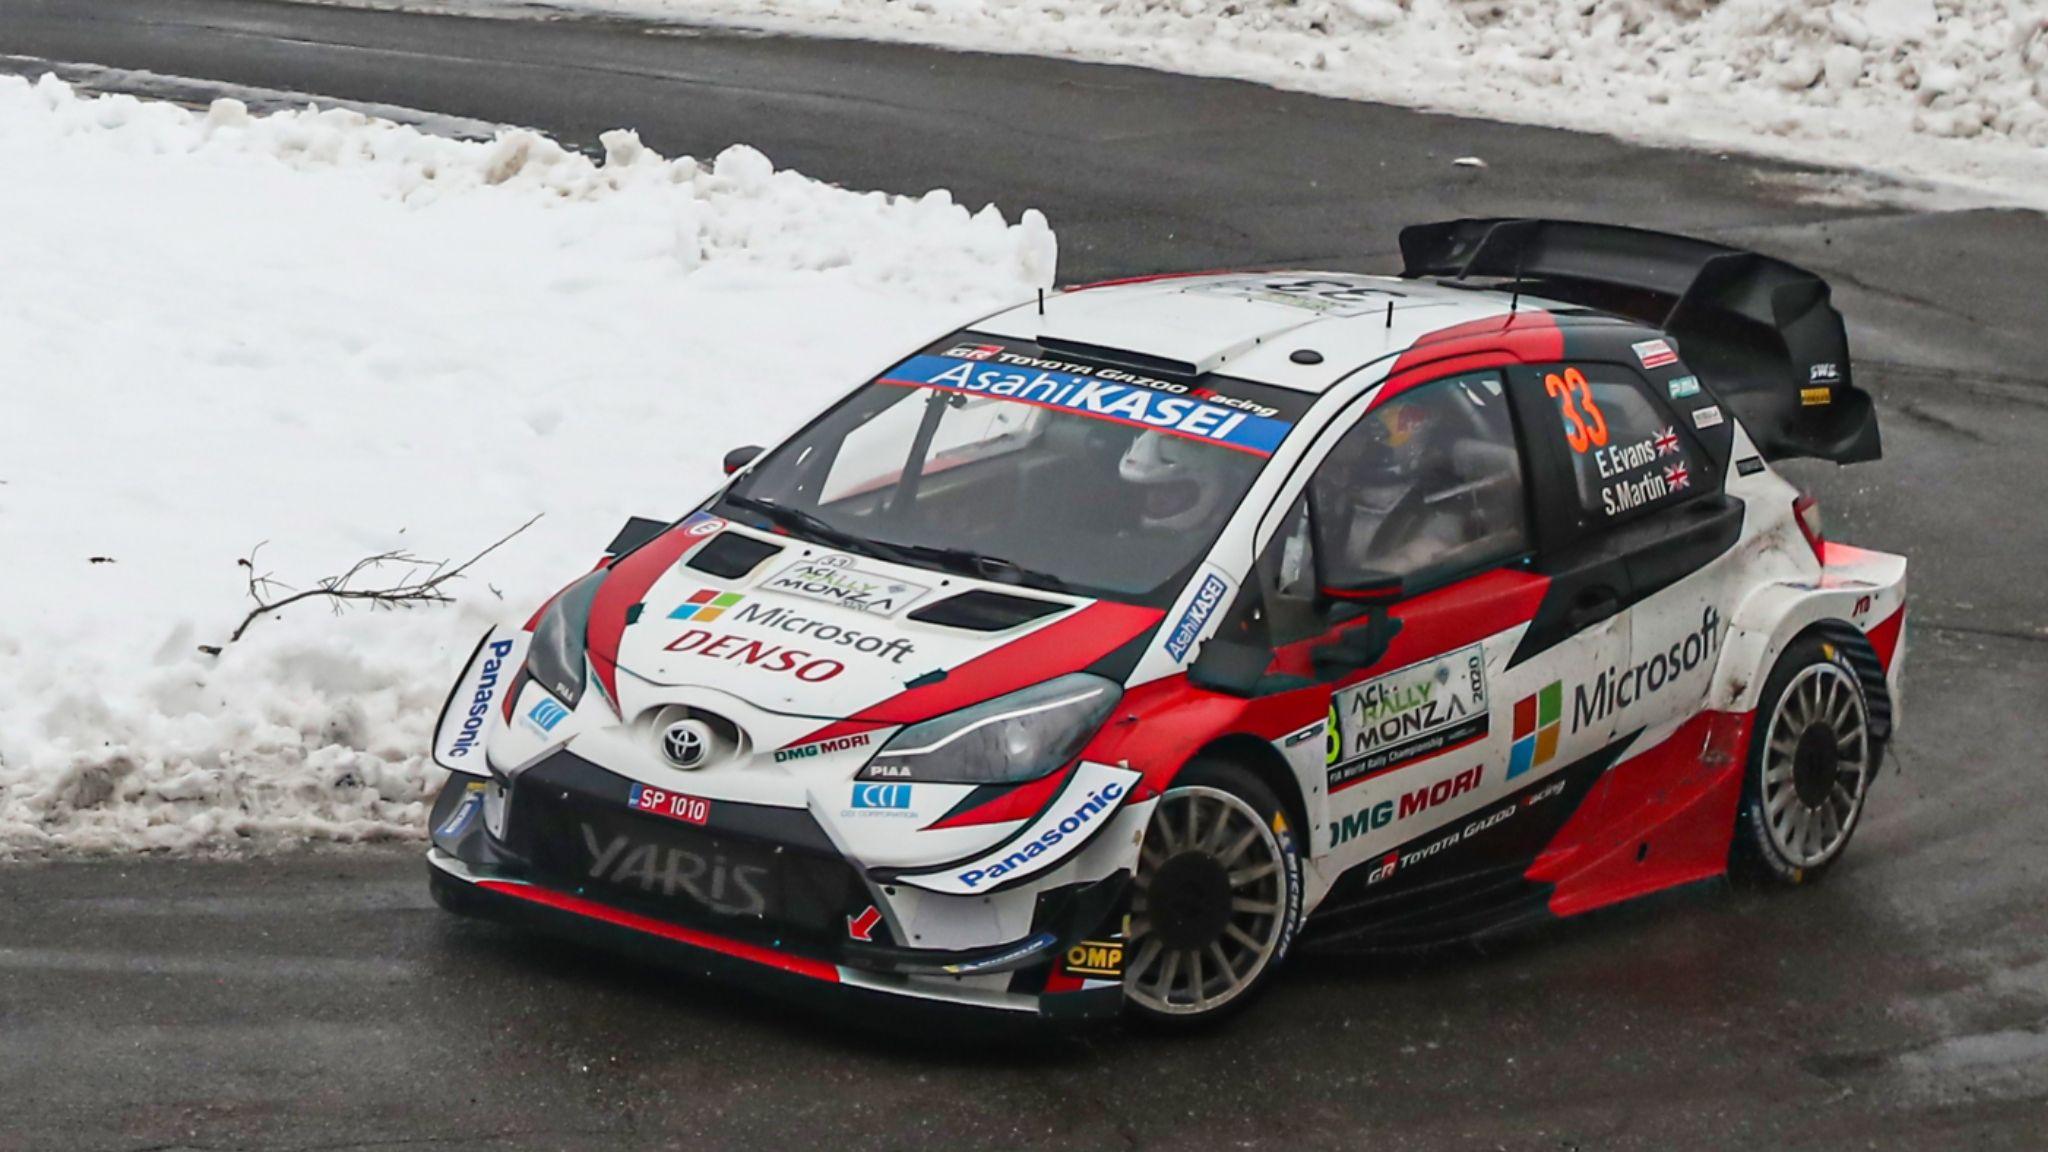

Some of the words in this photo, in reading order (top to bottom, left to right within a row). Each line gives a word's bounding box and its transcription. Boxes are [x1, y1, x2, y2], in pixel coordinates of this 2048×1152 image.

[926, 361, 1249, 439] AsahiKASEI
[941, 347, 998, 361] GR
[998, 353, 1093, 375] TOYOTA
[1095, 369, 1190, 395] GAZOO
[1191, 386, 1280, 418] Racing
[1545, 366, 1609, 454] 33
[1594, 439, 1657, 480] E.Evans
[1601, 472, 1667, 516] S.Martin
[773, 579, 893, 610] MONZA
[663, 629, 845, 682] DENSO
[734, 603, 915, 664] Microsoft
[1468, 656, 1484, 704] 2020
[1571, 605, 1720, 735] Microsoft
[448, 639, 514, 758] Panasonic
[1356, 693, 1467, 753] MONZA
[1362, 681, 1432, 727] RALLY
[775, 745, 819, 763] DMG
[820, 733, 871, 754] MORI
[870, 765, 912, 777] PIAA
[640, 788, 665, 810] SP
[670, 796, 706, 821] 1010
[1398, 763, 1484, 821] MORI
[957, 782, 1125, 888] Panasonic
[1367, 853, 1399, 885] GR
[1400, 833, 1461, 870] TOYOTA
[1463, 804, 1517, 839] GAZOO
[1067, 945, 1123, 969] OMP
